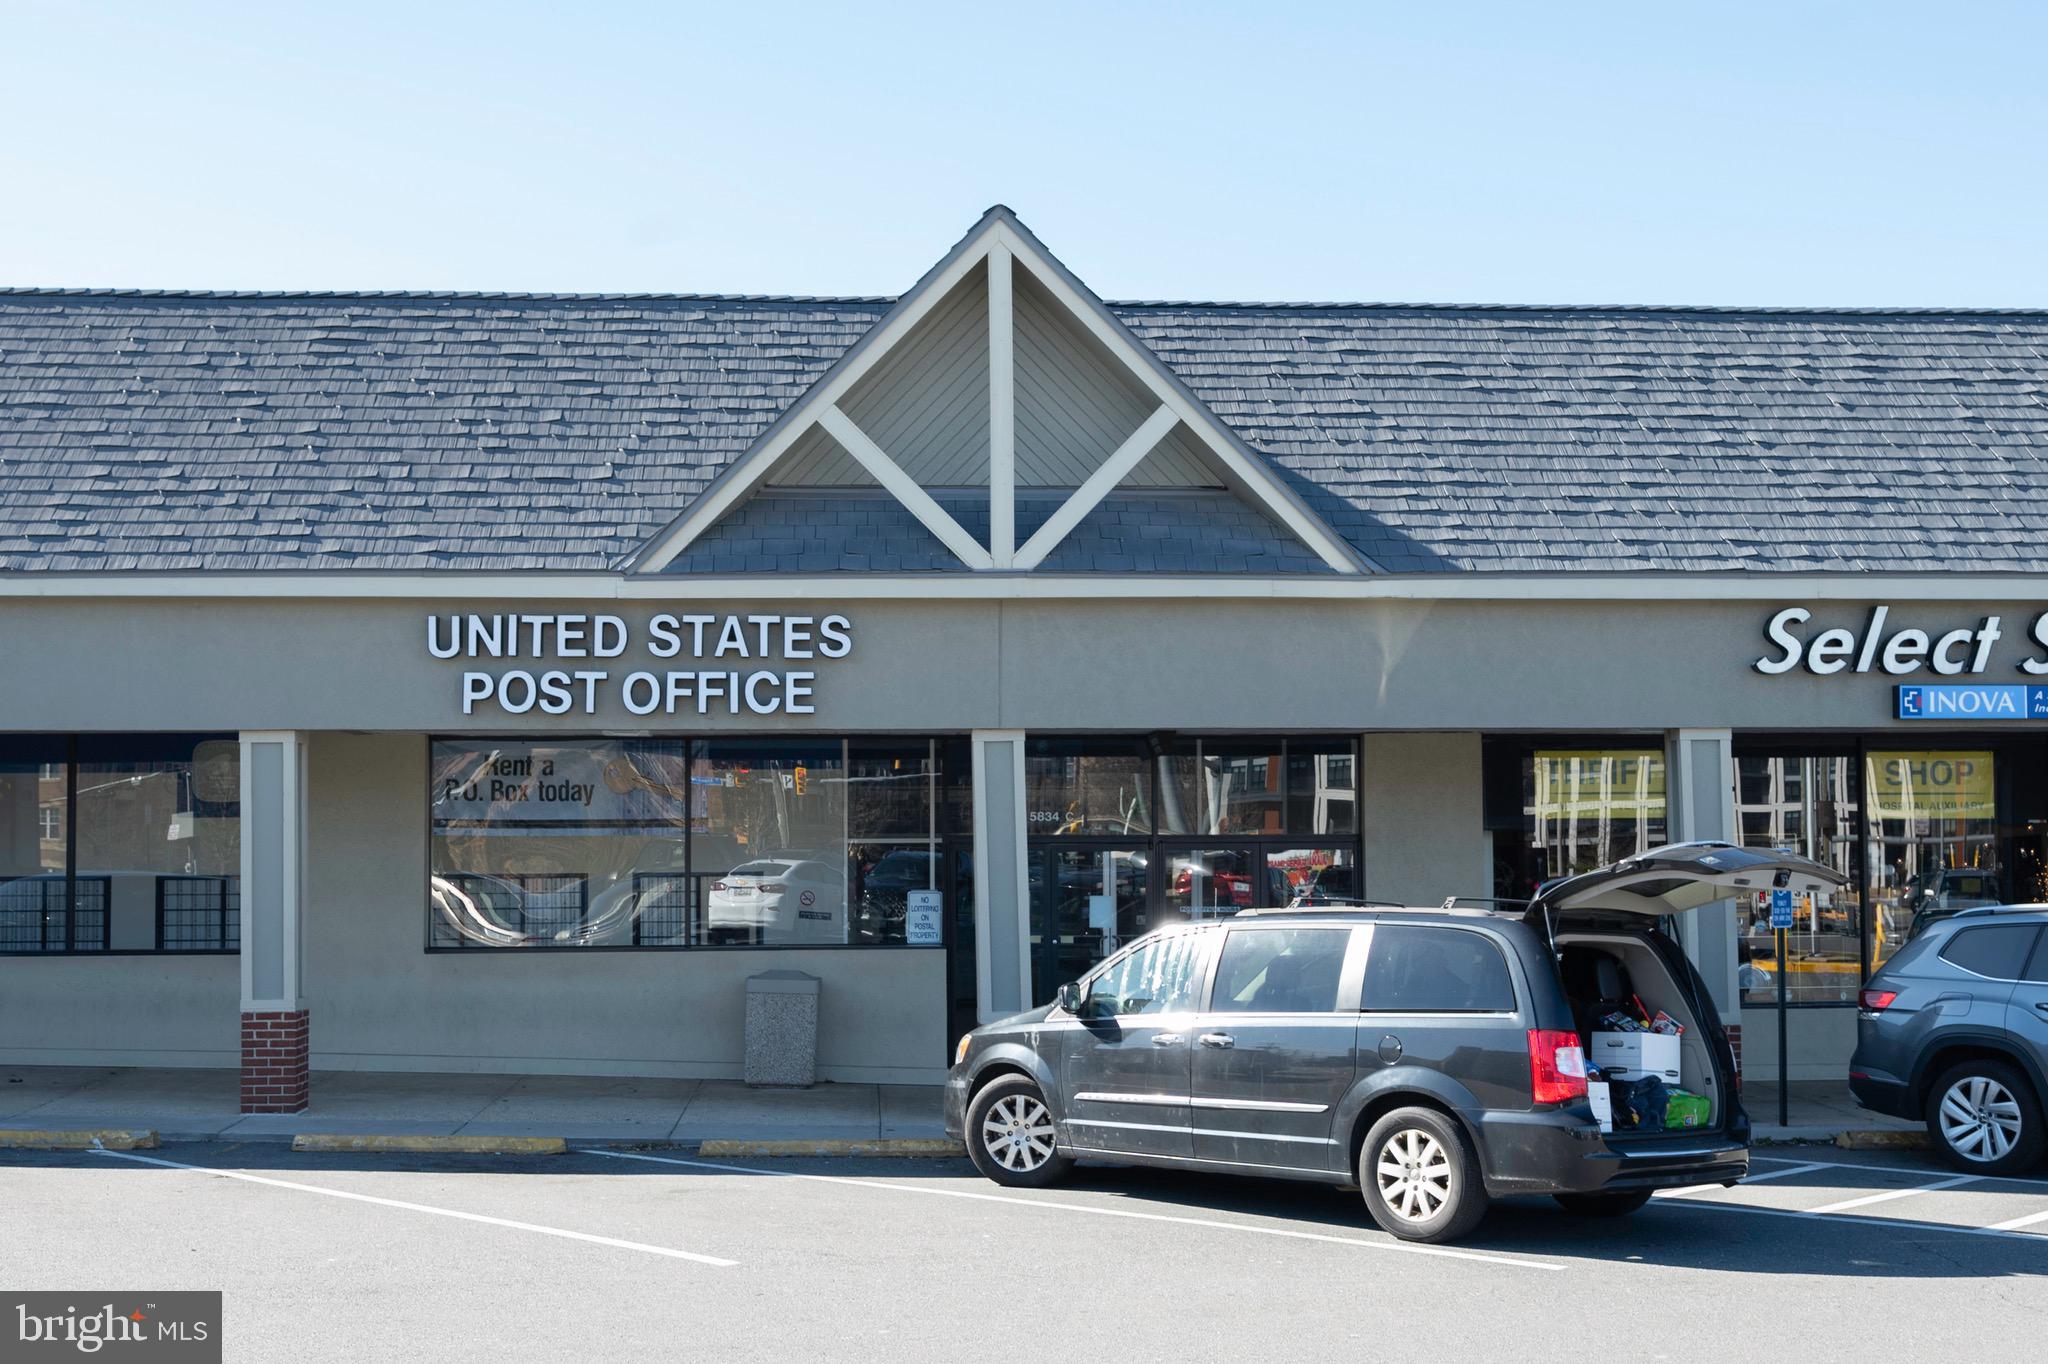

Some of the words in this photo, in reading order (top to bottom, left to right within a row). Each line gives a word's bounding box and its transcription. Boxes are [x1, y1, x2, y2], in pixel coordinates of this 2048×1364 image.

[427, 614, 629, 659] UNITED
[648, 614, 853, 658] STATES
[1753, 605, 2002, 676] Select
[462, 670, 608, 714] POST
[622, 671, 816, 715] OFFICE
[1928, 690, 2016, 713] INOVA
[484, 754, 532, 777] Rent
[542, 758, 555, 777] a
[1885, 760, 1974, 786] SHOP
[491, 780, 529, 802] Box
[539, 780, 596, 806] today
[1029, 811, 1060, 822] 5834
[1065, 811, 1075, 822] C
[921, 896, 930, 904] NO
